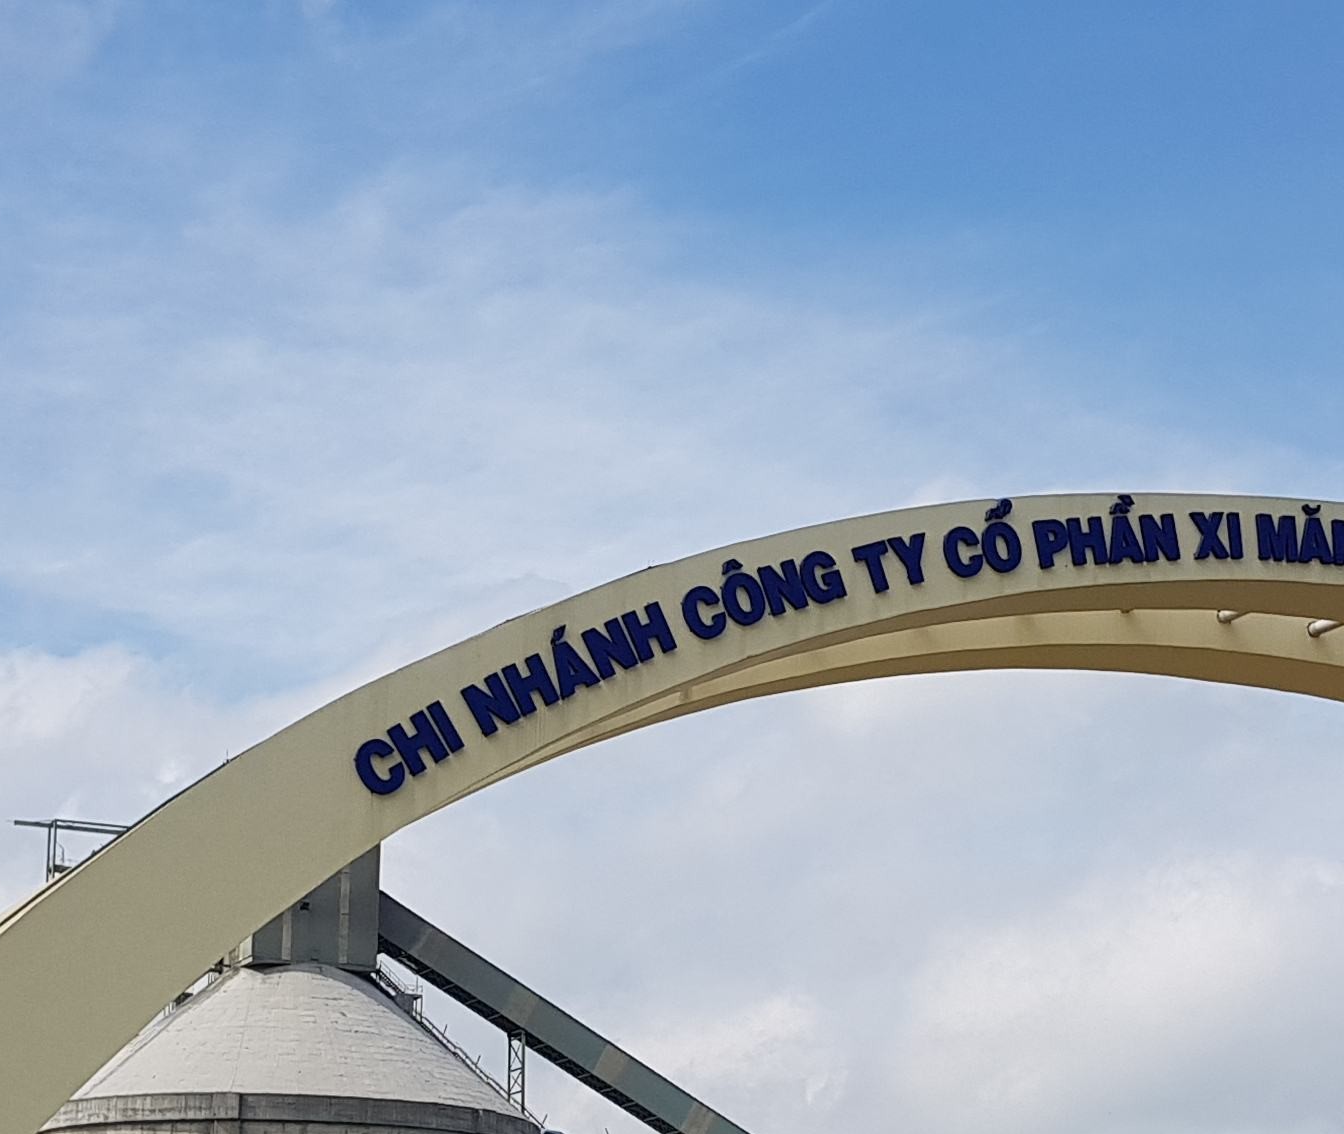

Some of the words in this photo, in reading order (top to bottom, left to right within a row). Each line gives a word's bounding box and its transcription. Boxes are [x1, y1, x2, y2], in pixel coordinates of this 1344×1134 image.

[354, 701, 464, 796] CHI
[461, 601, 677, 737] NHÁNH
[681, 549, 847, 640] CÔNG
[851, 532, 926, 593] TY
[943, 498, 1023, 579] CỔ
[1032, 494, 1180, 570] PHẦN
[1189, 511, 1244, 560] XI
